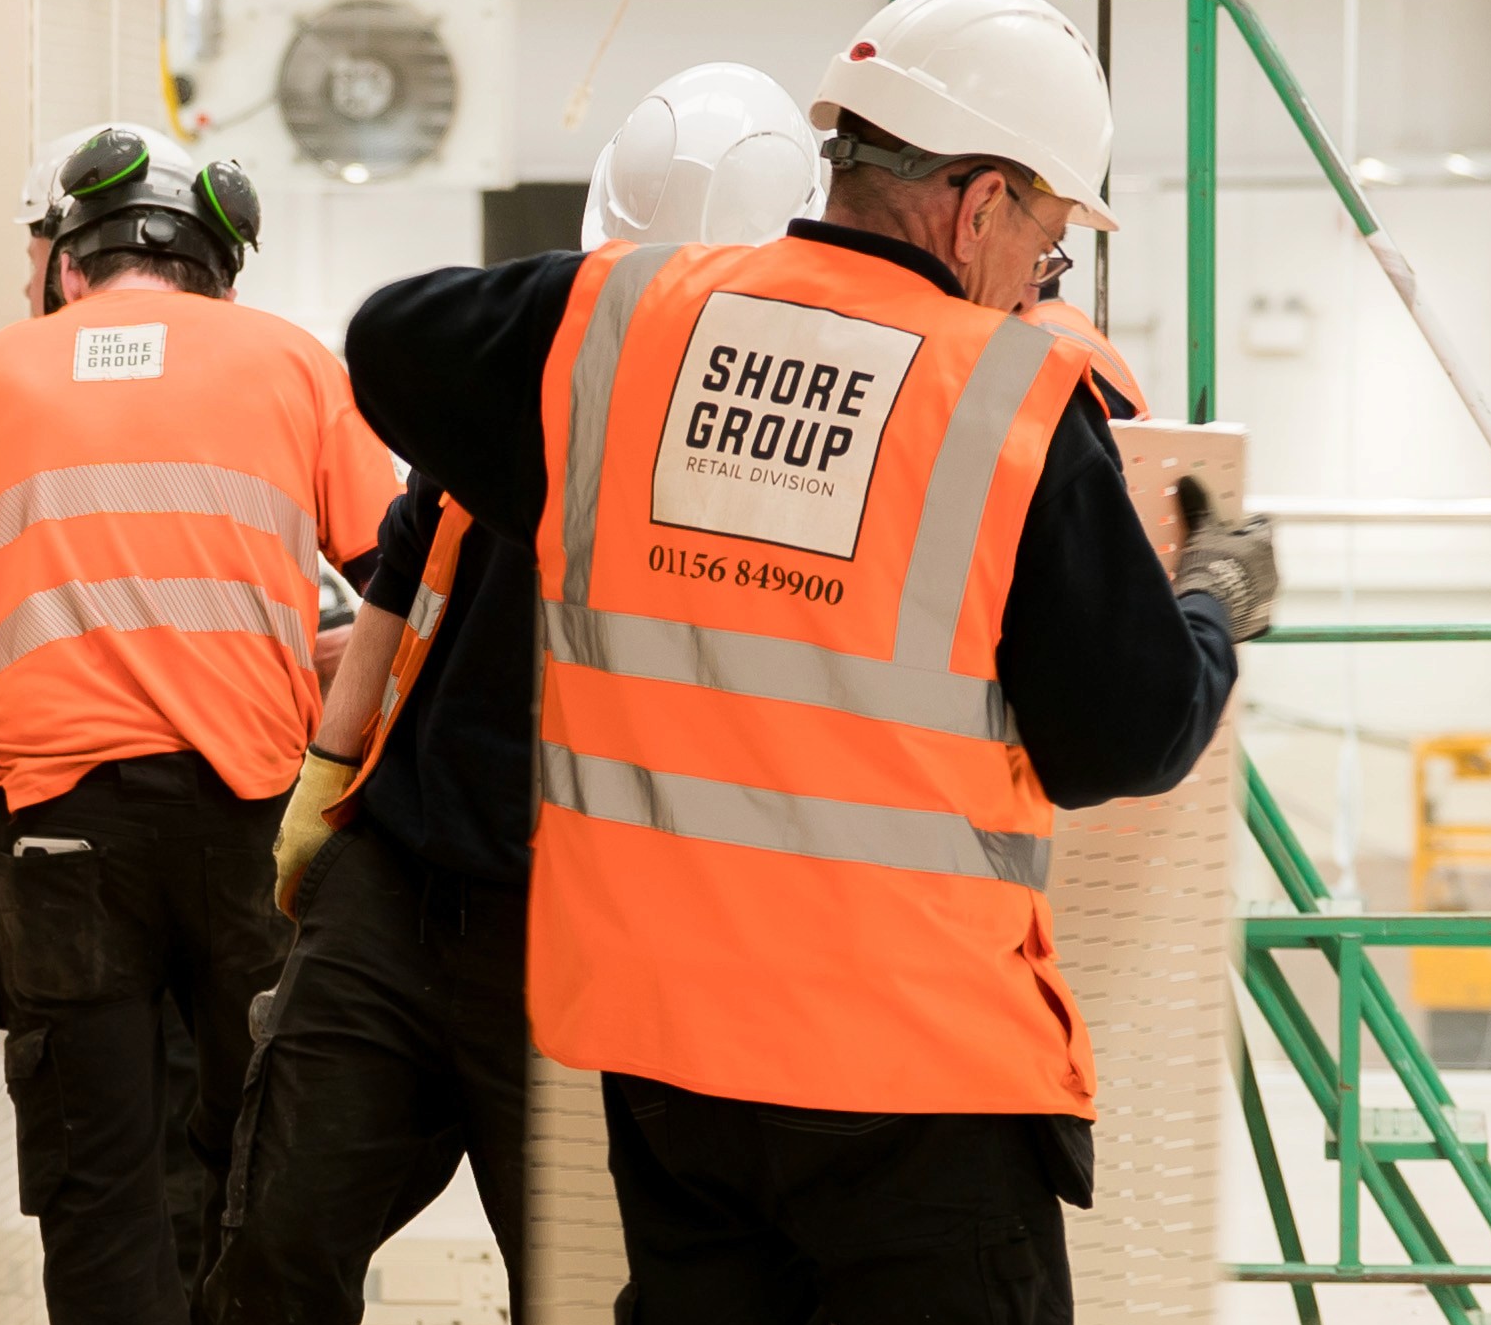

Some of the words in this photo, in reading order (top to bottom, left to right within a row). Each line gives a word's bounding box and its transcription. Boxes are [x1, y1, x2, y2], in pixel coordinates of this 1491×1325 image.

[88, 342, 152, 356] SHORE
[90, 333, 123, 344] THE
[87, 354, 151, 368] GROUP
[701, 344, 875, 418] SHORE
[685, 401, 854, 472] GROUP
[685, 456, 743, 481] RETAIL
[749, 467, 836, 497] DIVISION
[648, 544, 728, 583] 01156
[734, 558, 844, 606] 849900
